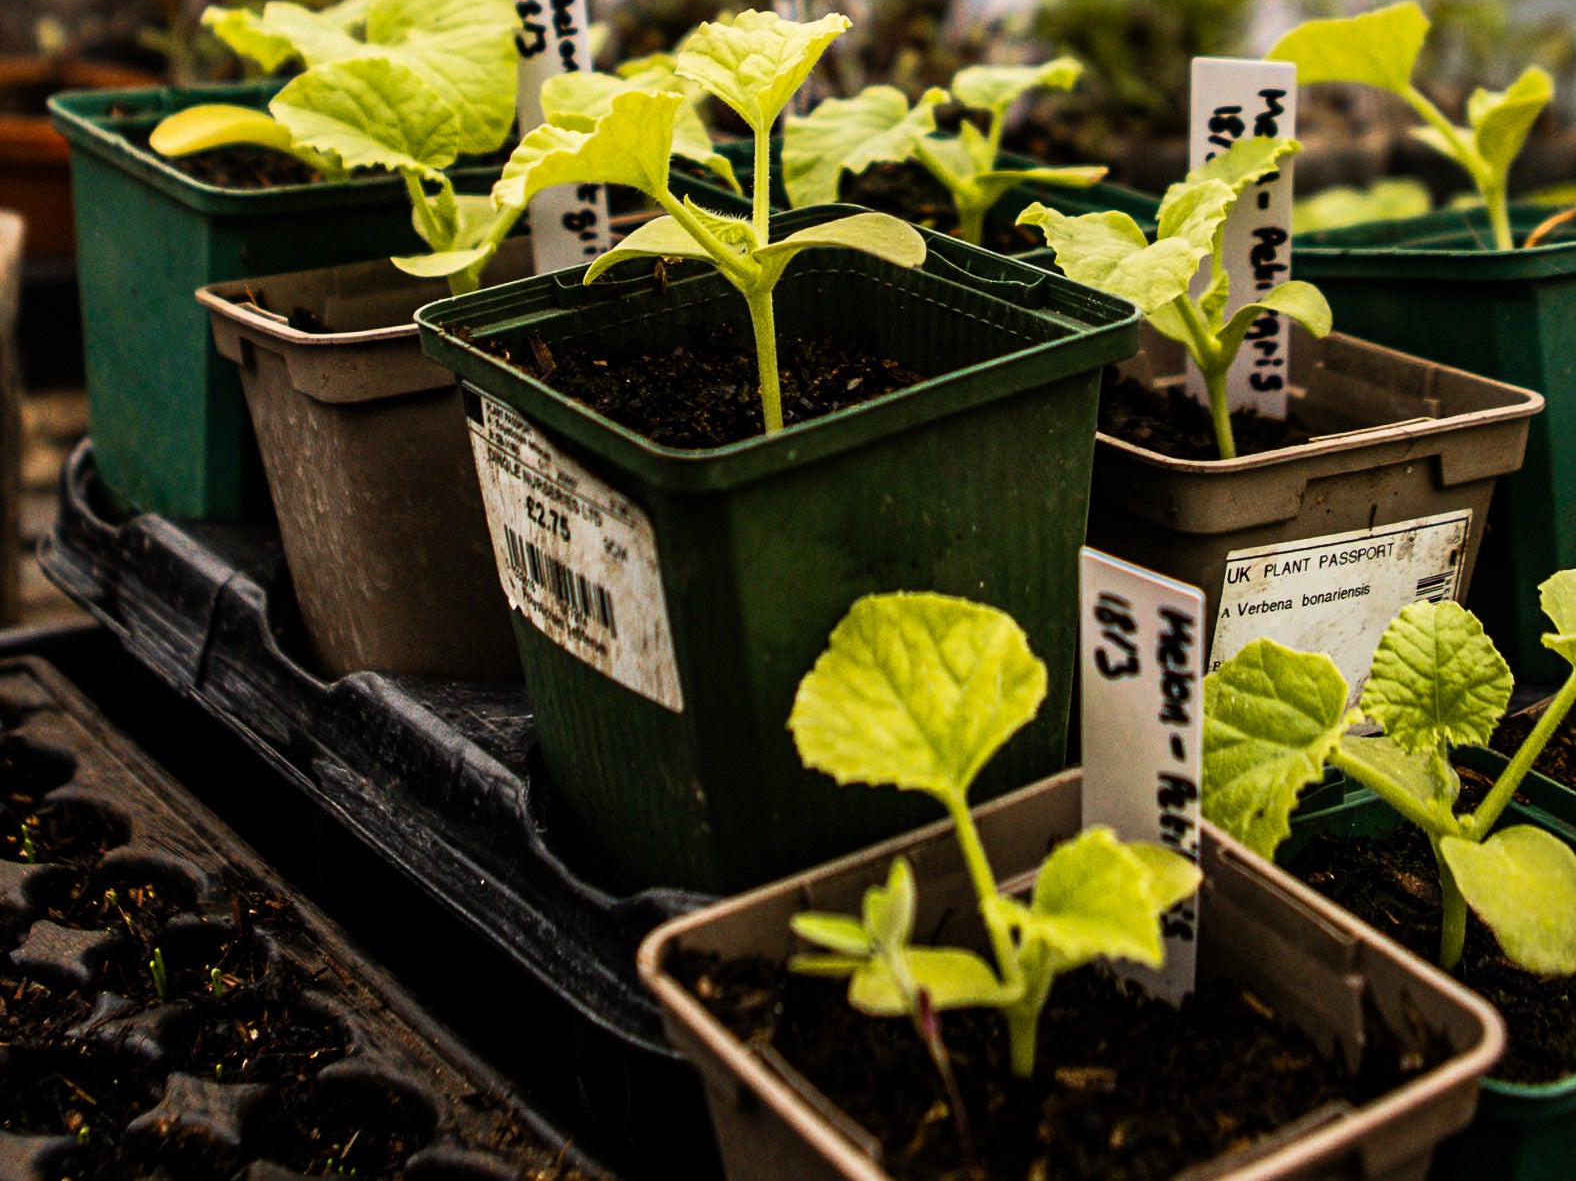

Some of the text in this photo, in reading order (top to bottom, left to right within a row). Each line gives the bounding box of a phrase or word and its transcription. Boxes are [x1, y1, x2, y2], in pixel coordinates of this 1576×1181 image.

[526, 495, 571, 542] £2.75
[1226, 542, 1395, 585] UK PLANT PASSPORT
[1237, 598, 1293, 617] Verbena
[1302, 582, 1371, 607] bonariensis
[1094, 592, 1140, 682] 18/3
[1157, 605, 1195, 725] Melon
